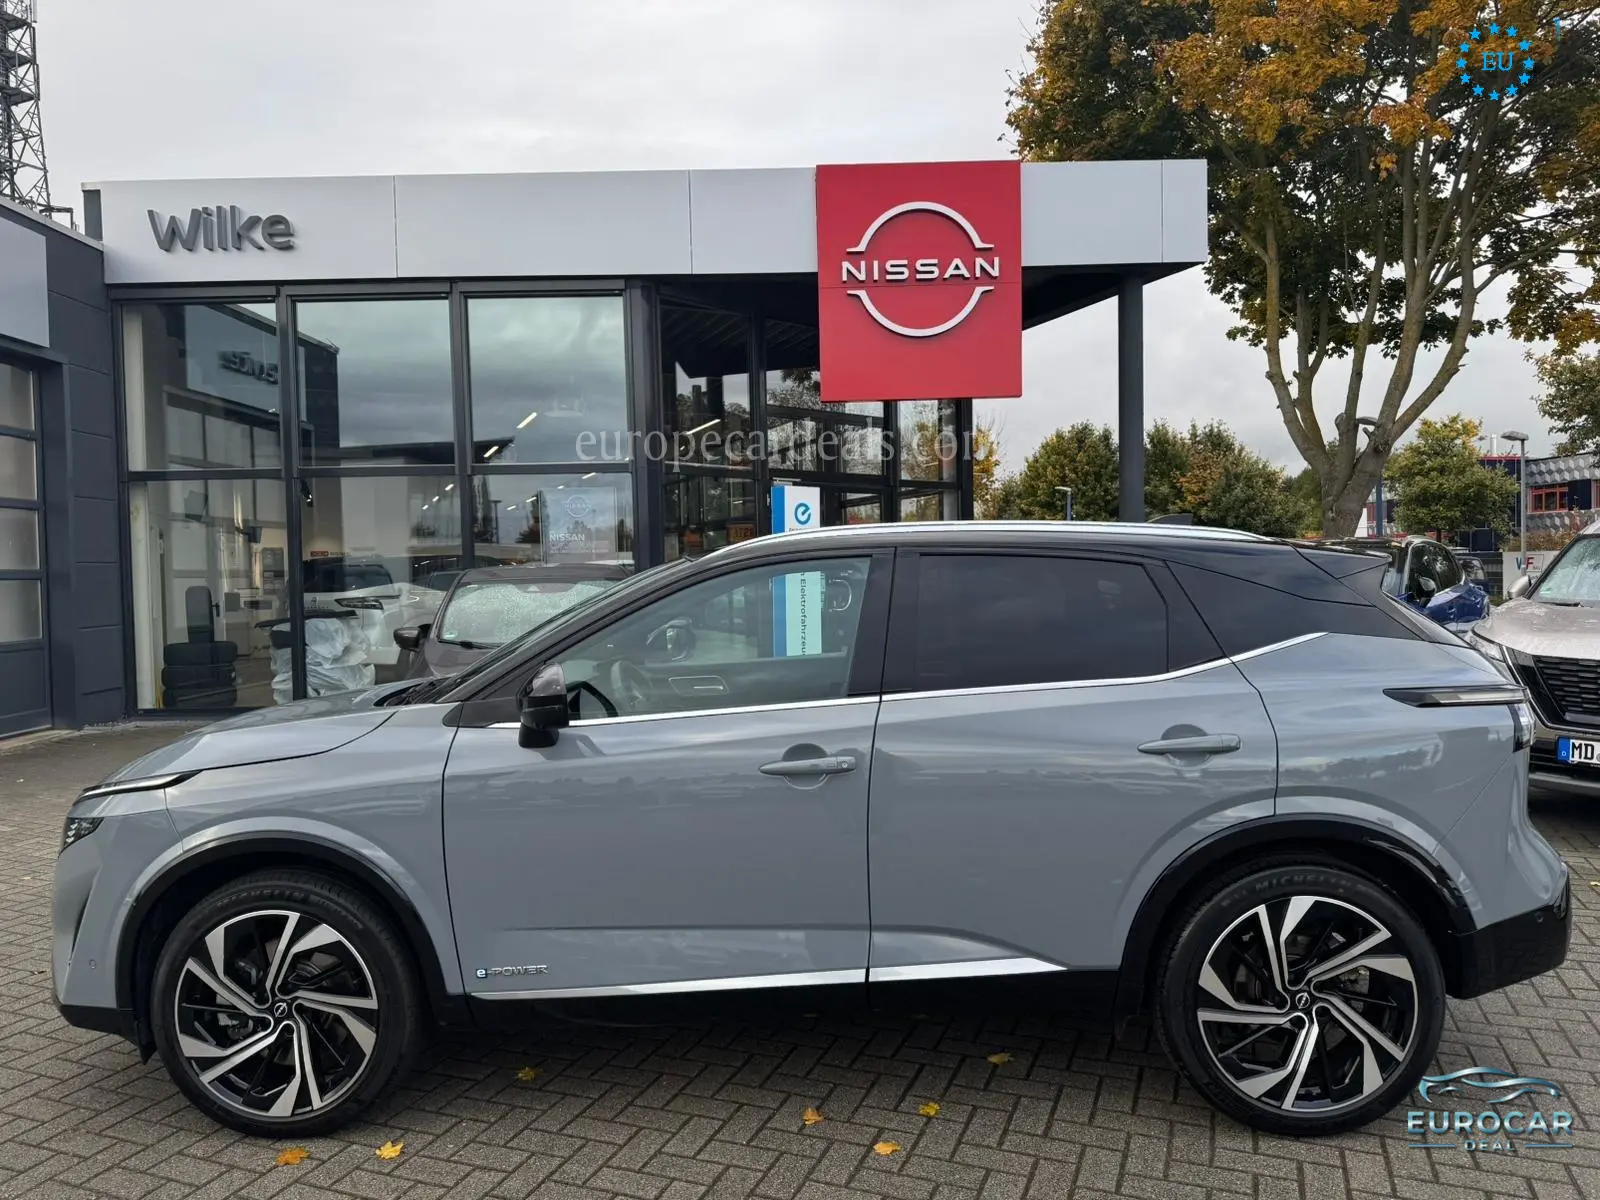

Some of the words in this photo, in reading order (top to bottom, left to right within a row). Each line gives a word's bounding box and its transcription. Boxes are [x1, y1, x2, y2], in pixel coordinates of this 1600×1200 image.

[147, 205, 295, 252] Wilke
[841, 256, 1000, 283] NISSAN
[549, 533, 585, 541] NISSAN
[1571, 741, 1595, 760] MD
[476, 965, 549, 977] e-POWER
